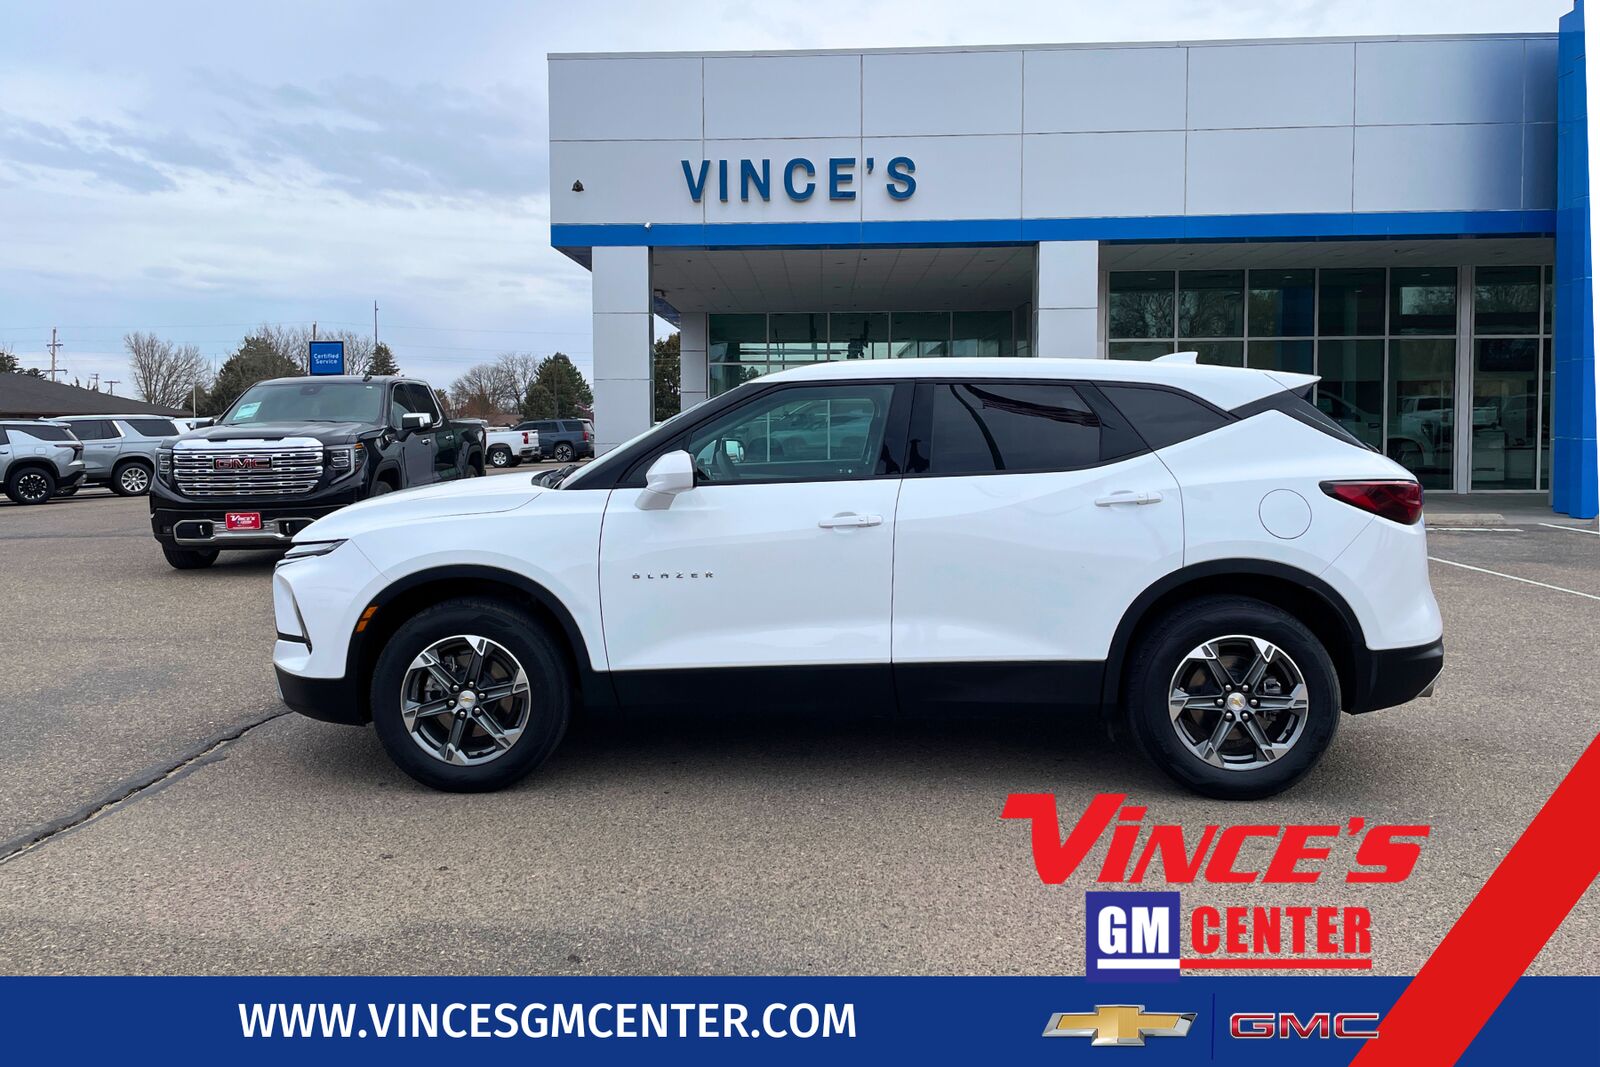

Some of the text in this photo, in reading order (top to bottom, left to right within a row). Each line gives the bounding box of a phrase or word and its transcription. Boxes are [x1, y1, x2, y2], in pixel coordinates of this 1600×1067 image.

[681, 157, 917, 202] VINCE'S
[215, 458, 270, 469] GMC
[631, 571, 714, 580] BLAZER
